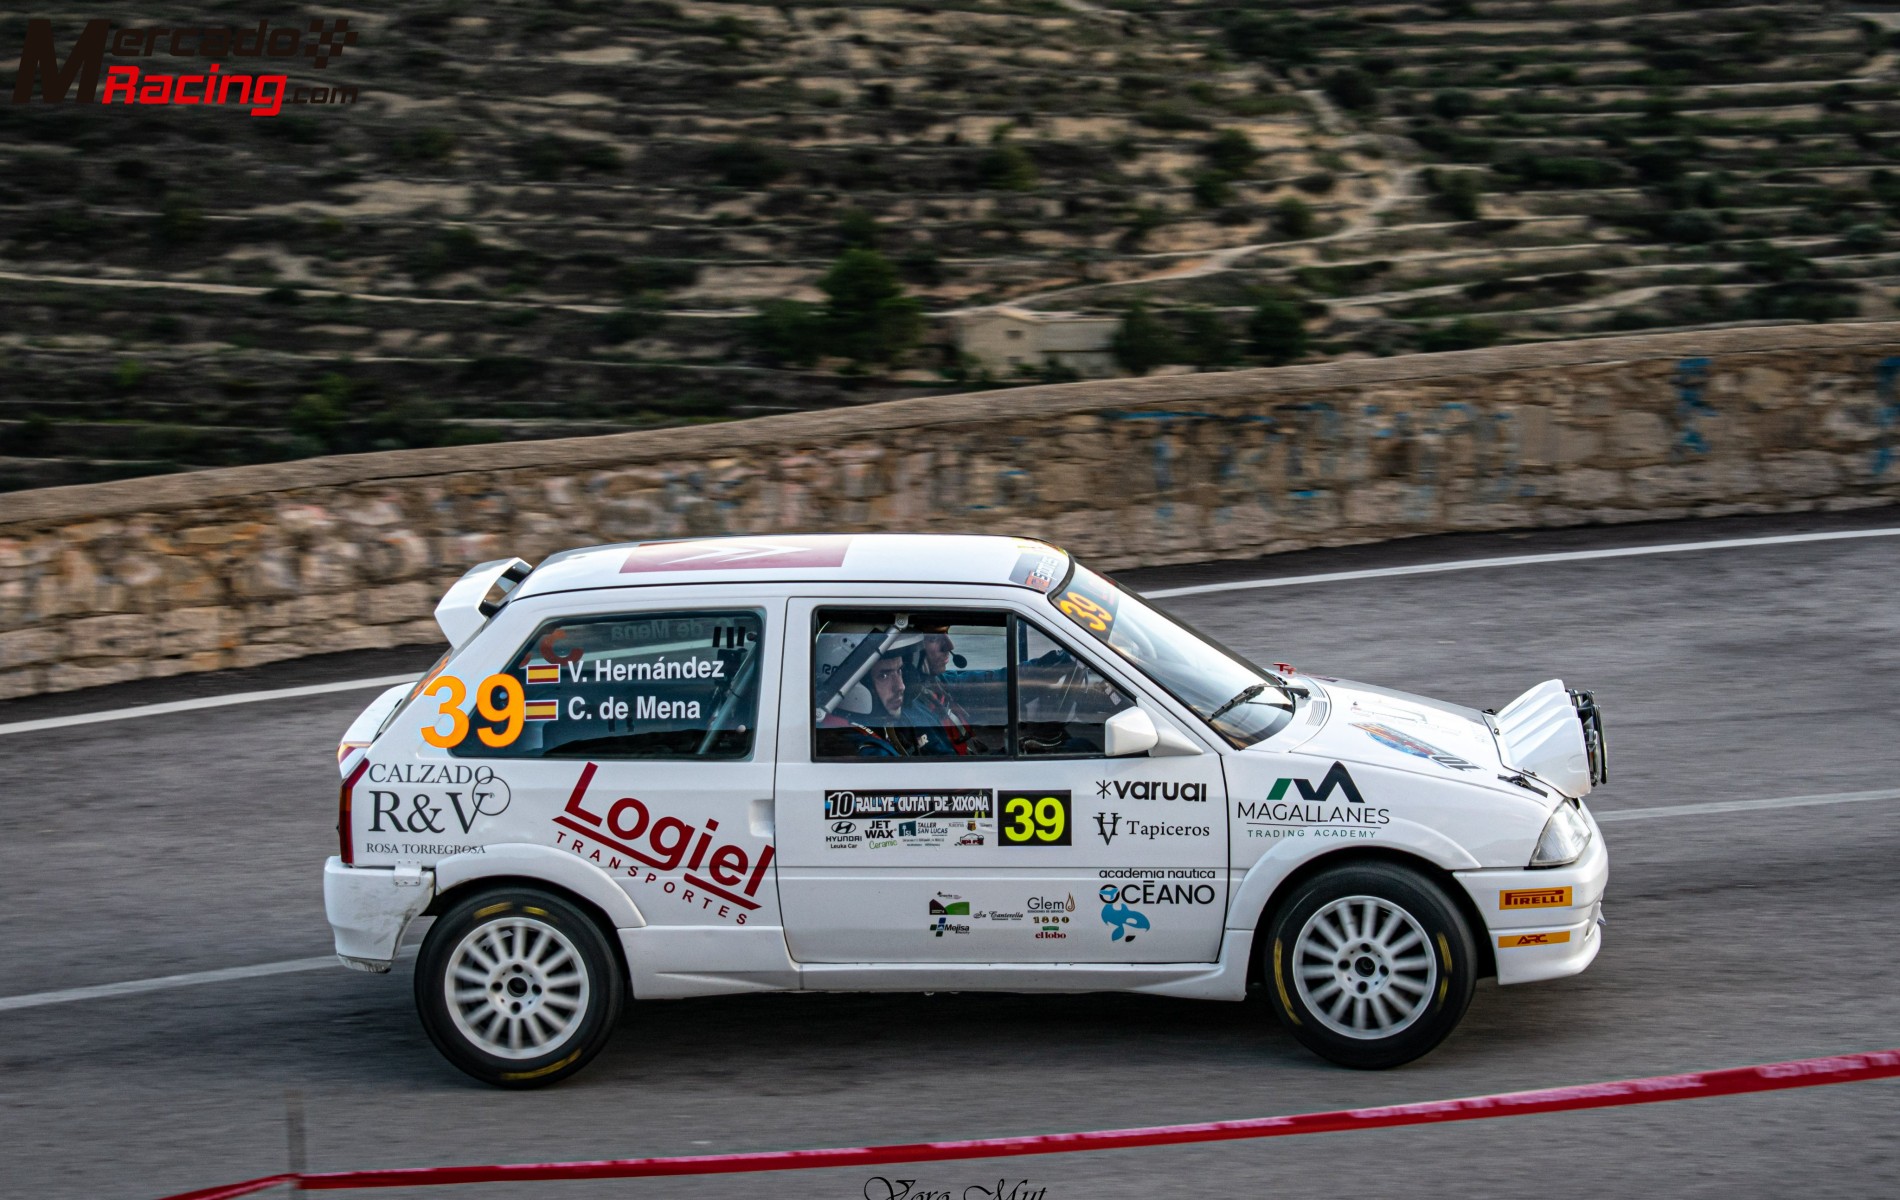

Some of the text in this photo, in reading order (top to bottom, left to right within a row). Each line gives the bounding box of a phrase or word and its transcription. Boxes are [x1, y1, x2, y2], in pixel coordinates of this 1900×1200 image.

[1060, 592, 1113, 631] 39
[567, 656, 725, 683] V. Hernández
[420, 673, 526, 749] 39
[568, 695, 701, 720] C. de Mena
[368, 763, 494, 785] CALZADO
[368, 790, 489, 834] R&V
[828, 791, 989, 818] 10 RALLYE CIUTAT DE XIXONA
[1237, 801, 1390, 825] MAGALLANES
[564, 761, 777, 897] Logiel
[869, 820, 891, 829] JET
[1004, 797, 1066, 842] 39
[1126, 820, 1210, 840] Tapiceros
[864, 829, 895, 839] WAX
[868, 839, 898, 850] Ceramic
[1247, 829, 1377, 839] TRADING ACADEMY
[366, 843, 486, 855] ROSA TORREGROSA
[556, 831, 748, 925] TRANSPORTES
[1099, 867, 1216, 880] academia nautica
[1027, 896, 1065, 910] Glem
[1505, 889, 1565, 906] PIRELLI
[1044, 932, 1067, 940] lobo
